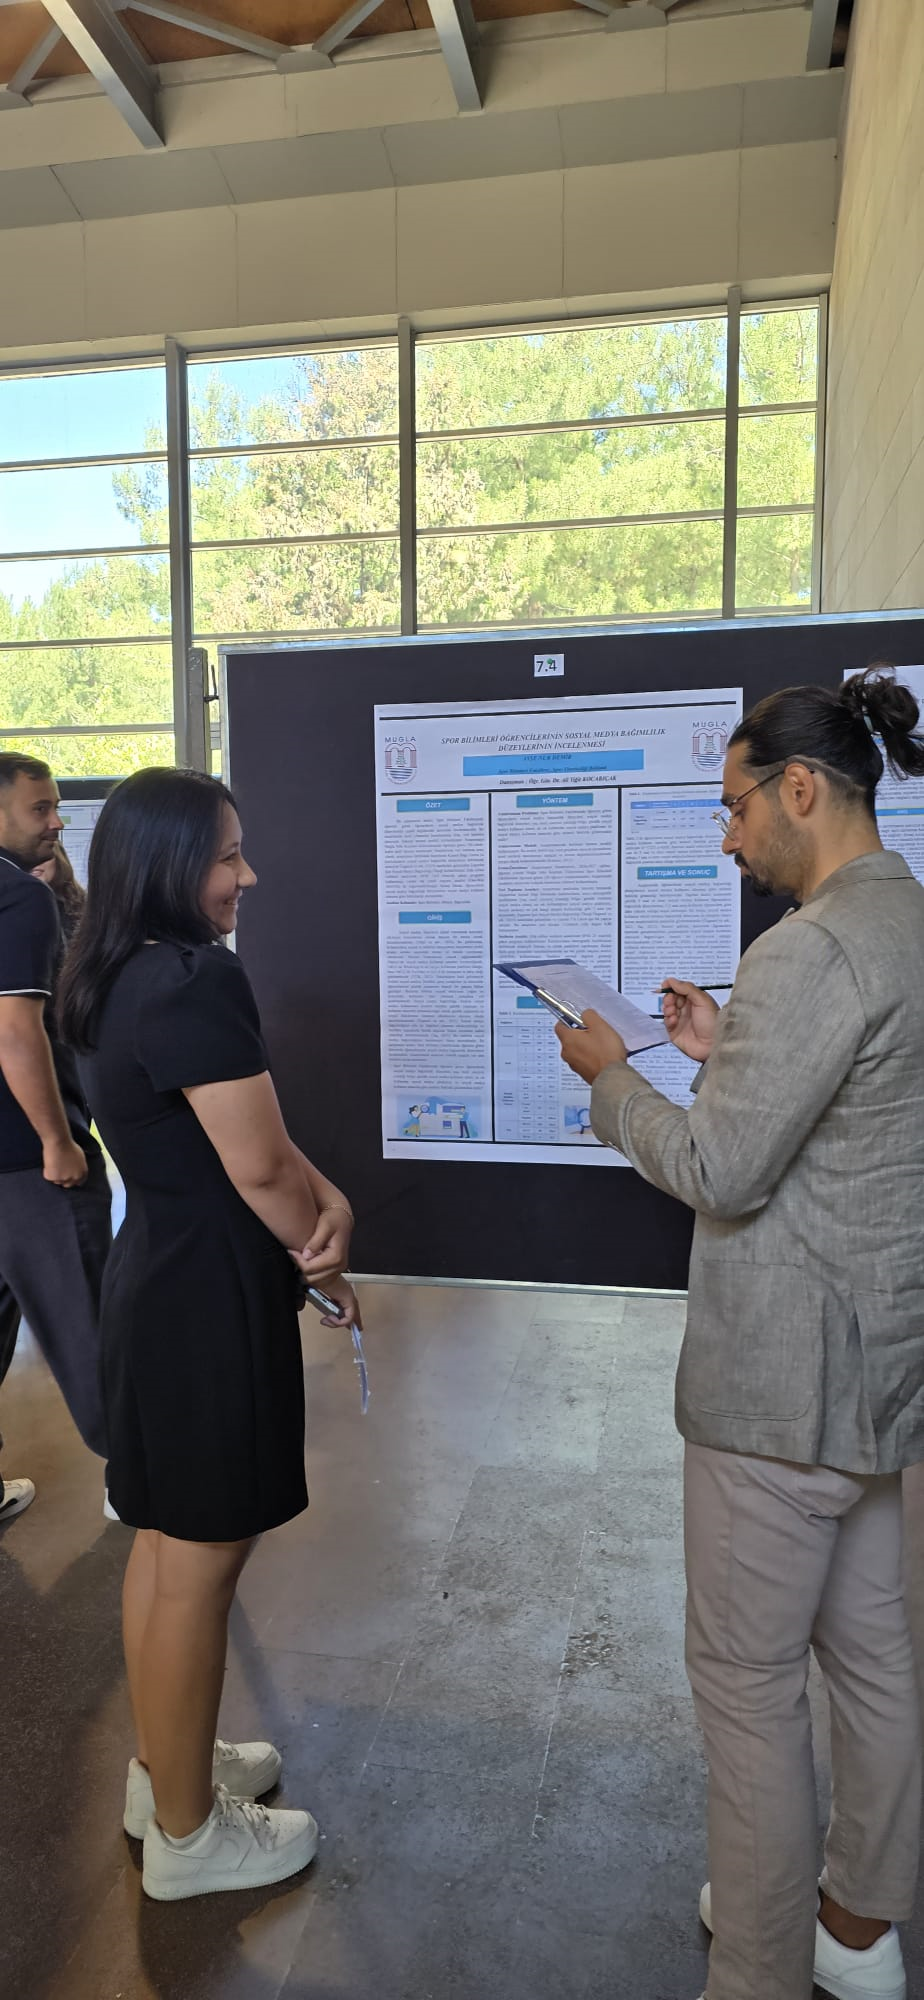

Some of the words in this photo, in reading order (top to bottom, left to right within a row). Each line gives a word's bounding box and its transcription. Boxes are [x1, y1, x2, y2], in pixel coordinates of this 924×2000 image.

[536, 660, 558, 672] 7.4
[564, 731, 591, 739] SOSYAL
[593, 730, 619, 738] MEDYA
[541, 796, 569, 804] YÖNTEM
